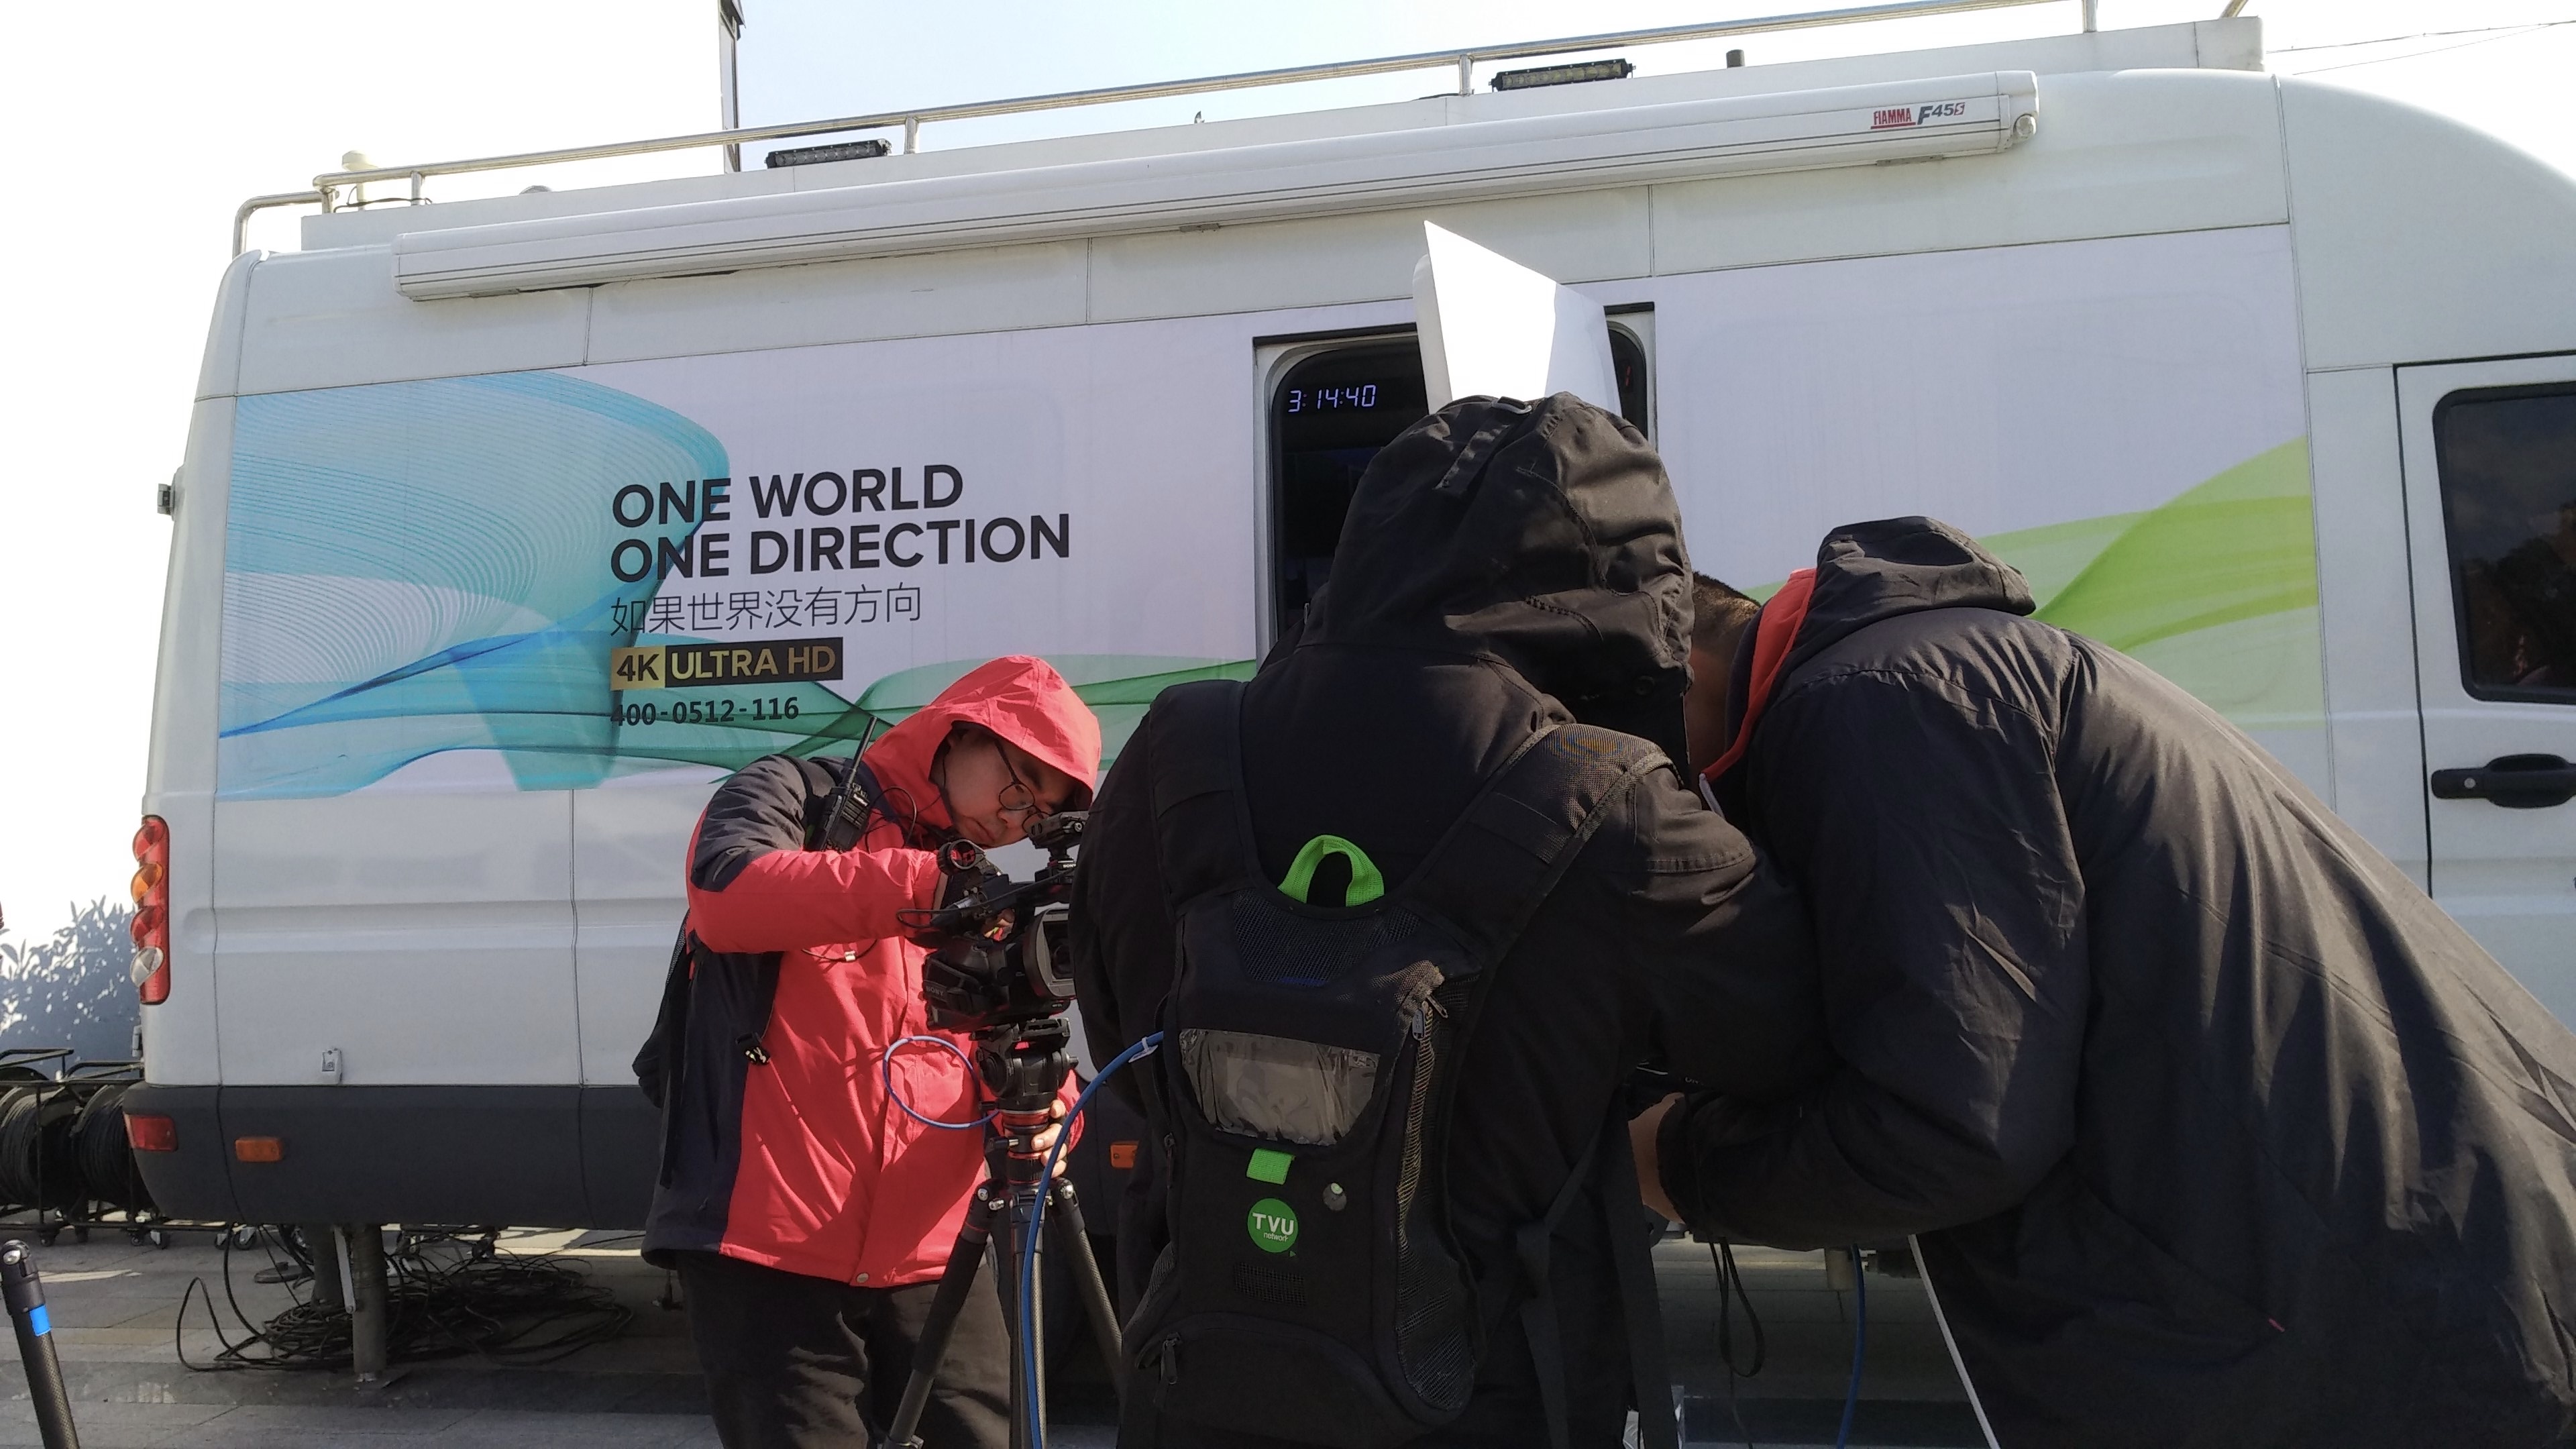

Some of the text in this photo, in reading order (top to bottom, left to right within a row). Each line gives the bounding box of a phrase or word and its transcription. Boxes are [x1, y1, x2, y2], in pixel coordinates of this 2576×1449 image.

[1874, 108, 1912, 125] FIAMMA
[1287, 384, 1377, 413] 3:14:40
[612, 464, 964, 528] ONE WORLD
[610, 513, 1070, 583] ONE DIRECTION
[610, 582, 922, 637] 如果世界没有方向
[616, 645, 837, 683] 4K ULTRA HD
[610, 696, 800, 727] 400-0512-116
[1252, 1213, 1294, 1235] TVU
[1264, 1232, 1288, 1242] network
